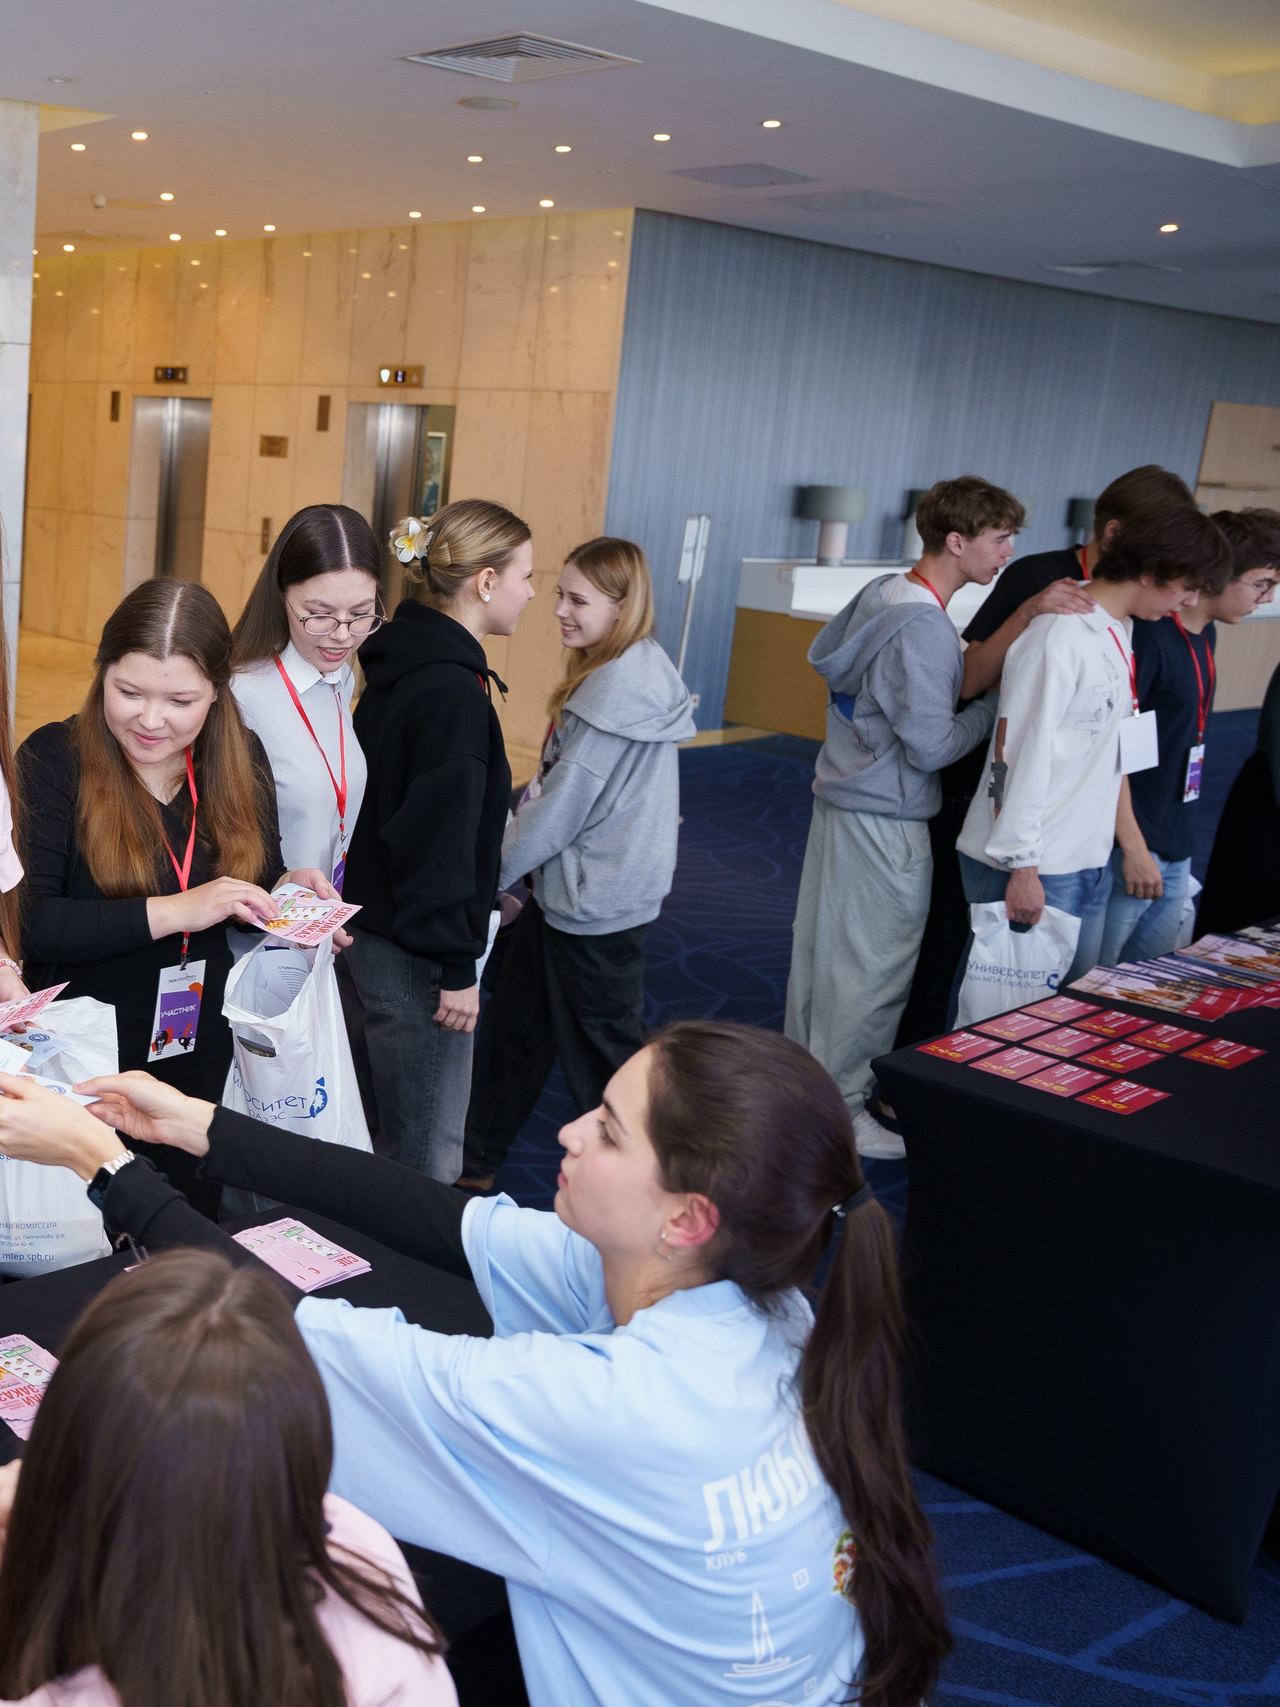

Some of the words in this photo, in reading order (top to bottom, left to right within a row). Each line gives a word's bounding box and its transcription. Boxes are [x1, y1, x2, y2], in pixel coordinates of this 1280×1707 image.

[295, 919, 325, 938] ЗАКАЗ
[319, 906, 352, 933] СДЕЛАЙ
[968, 961, 1046, 979] Университет
[161, 1004, 197, 1018] УЧАСТНИК
[16, 1222, 57, 1230] КОМИССИЯ
[705, 1548, 747, 1571] КЛУБ
